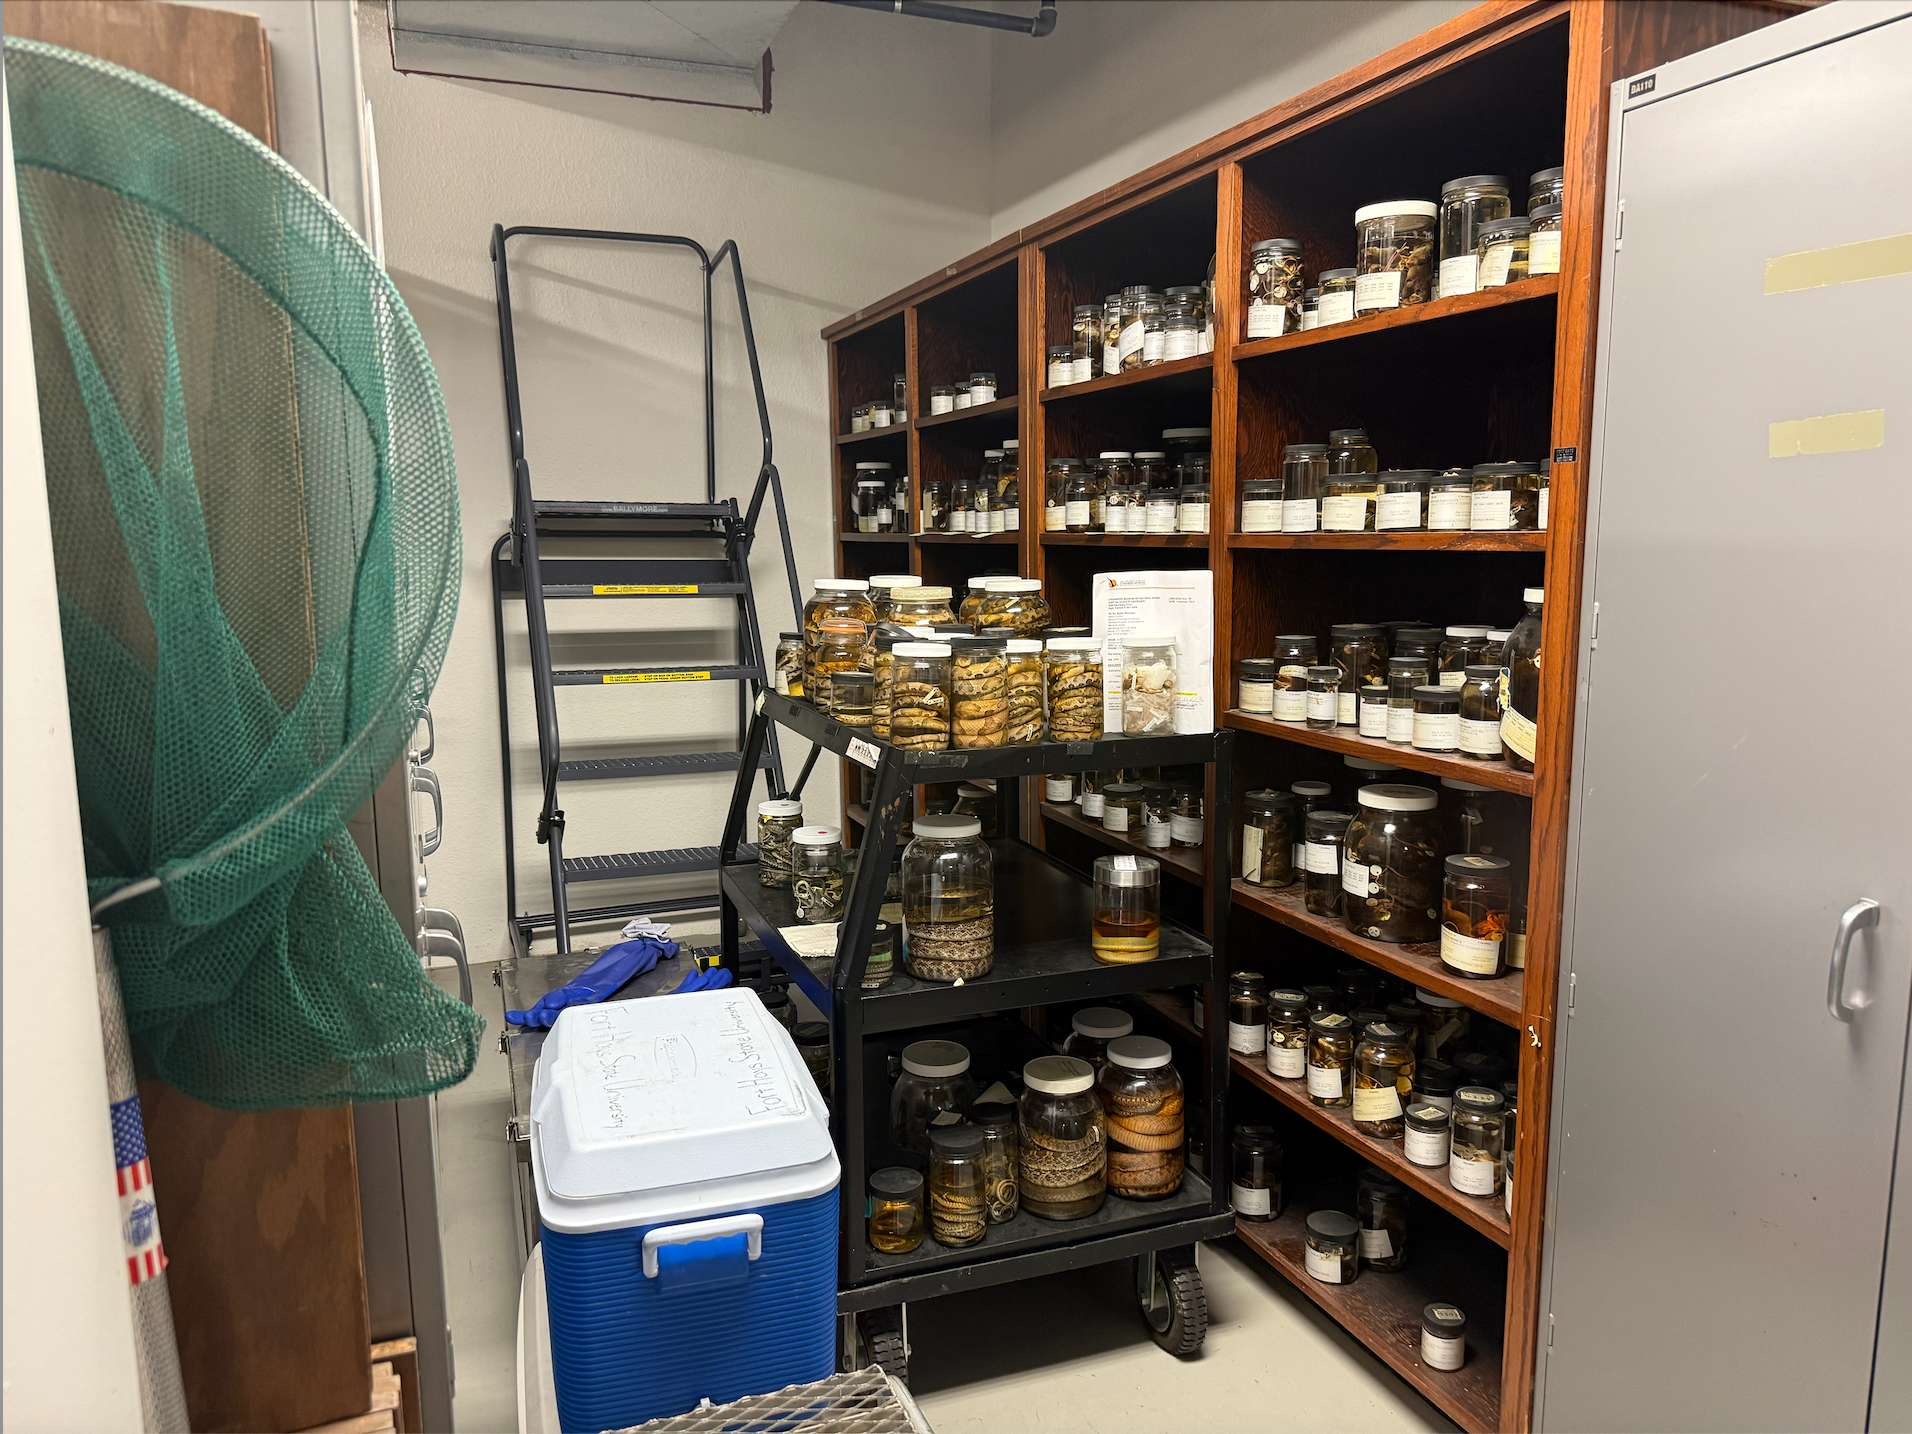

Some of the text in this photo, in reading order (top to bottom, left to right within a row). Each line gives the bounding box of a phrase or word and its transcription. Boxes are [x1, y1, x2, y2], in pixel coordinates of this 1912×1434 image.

[584, 1006, 646, 1130] Fort Hays State University
[718, 1000, 786, 1117] Fort Hays State University
